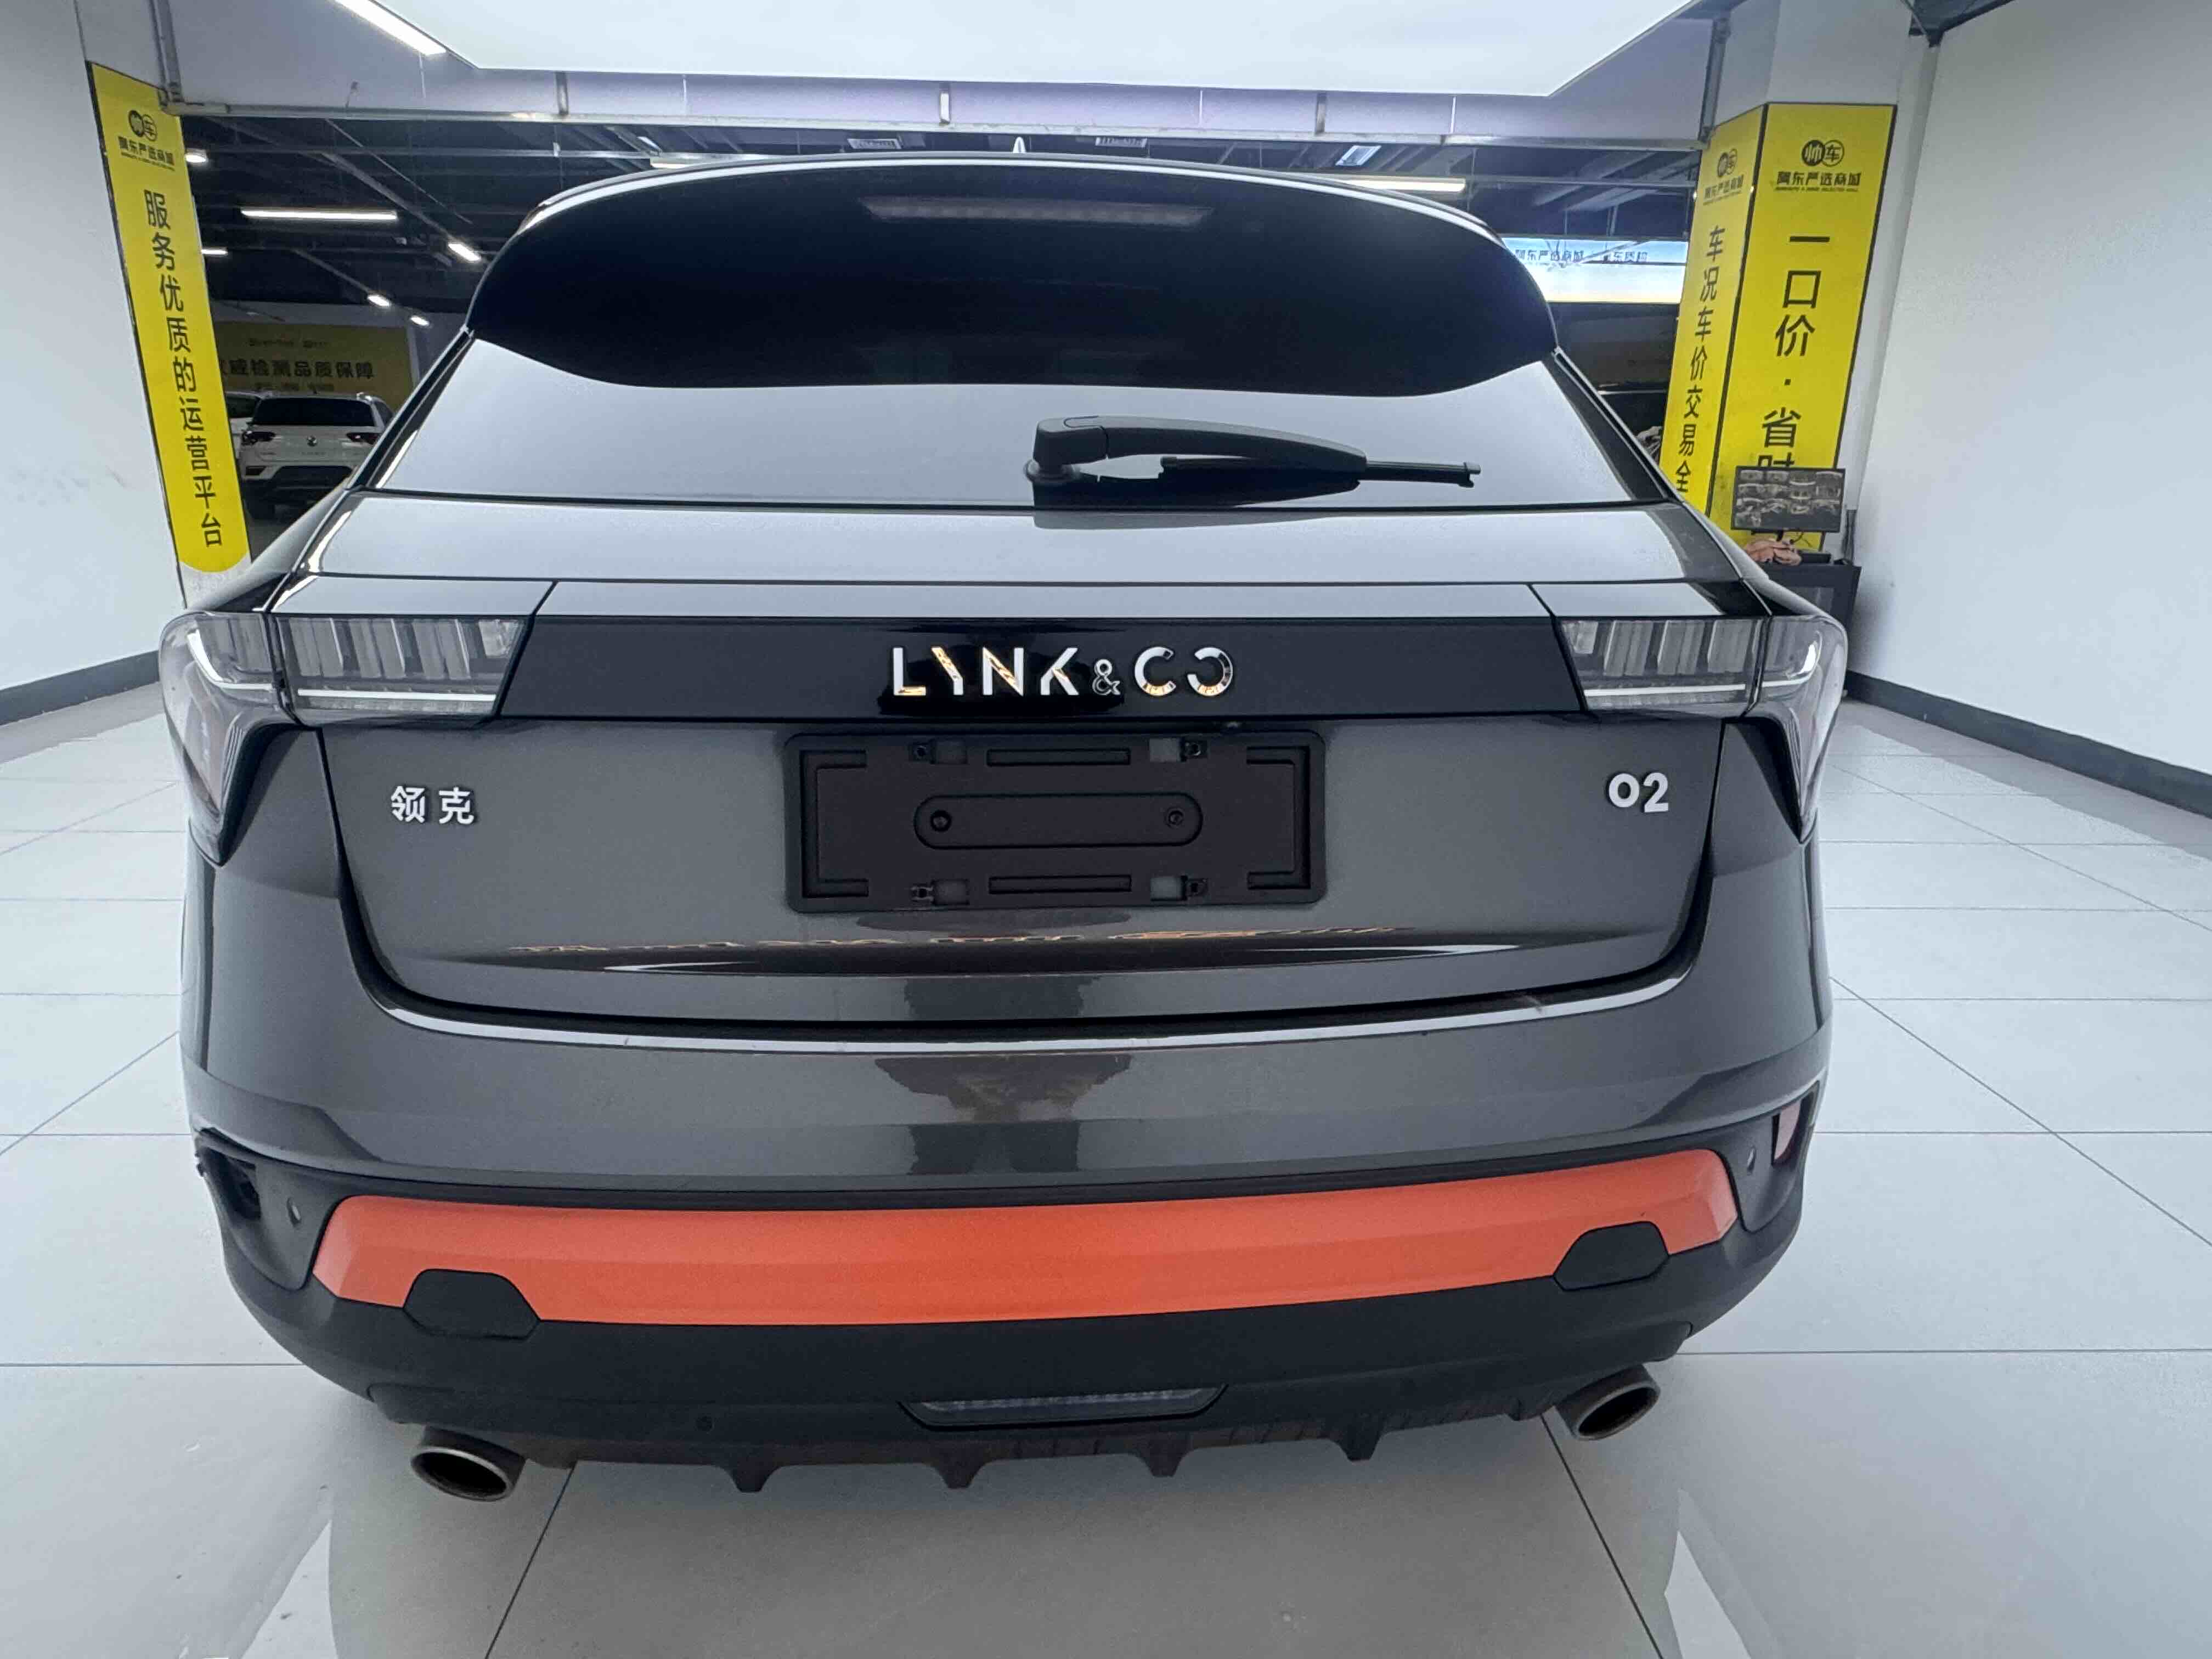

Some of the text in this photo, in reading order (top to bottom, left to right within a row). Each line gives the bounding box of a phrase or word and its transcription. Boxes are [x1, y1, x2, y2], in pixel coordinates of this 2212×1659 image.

[144, 189, 223, 548] 服务优质的运营平台
[390, 785, 475, 825] 领克
